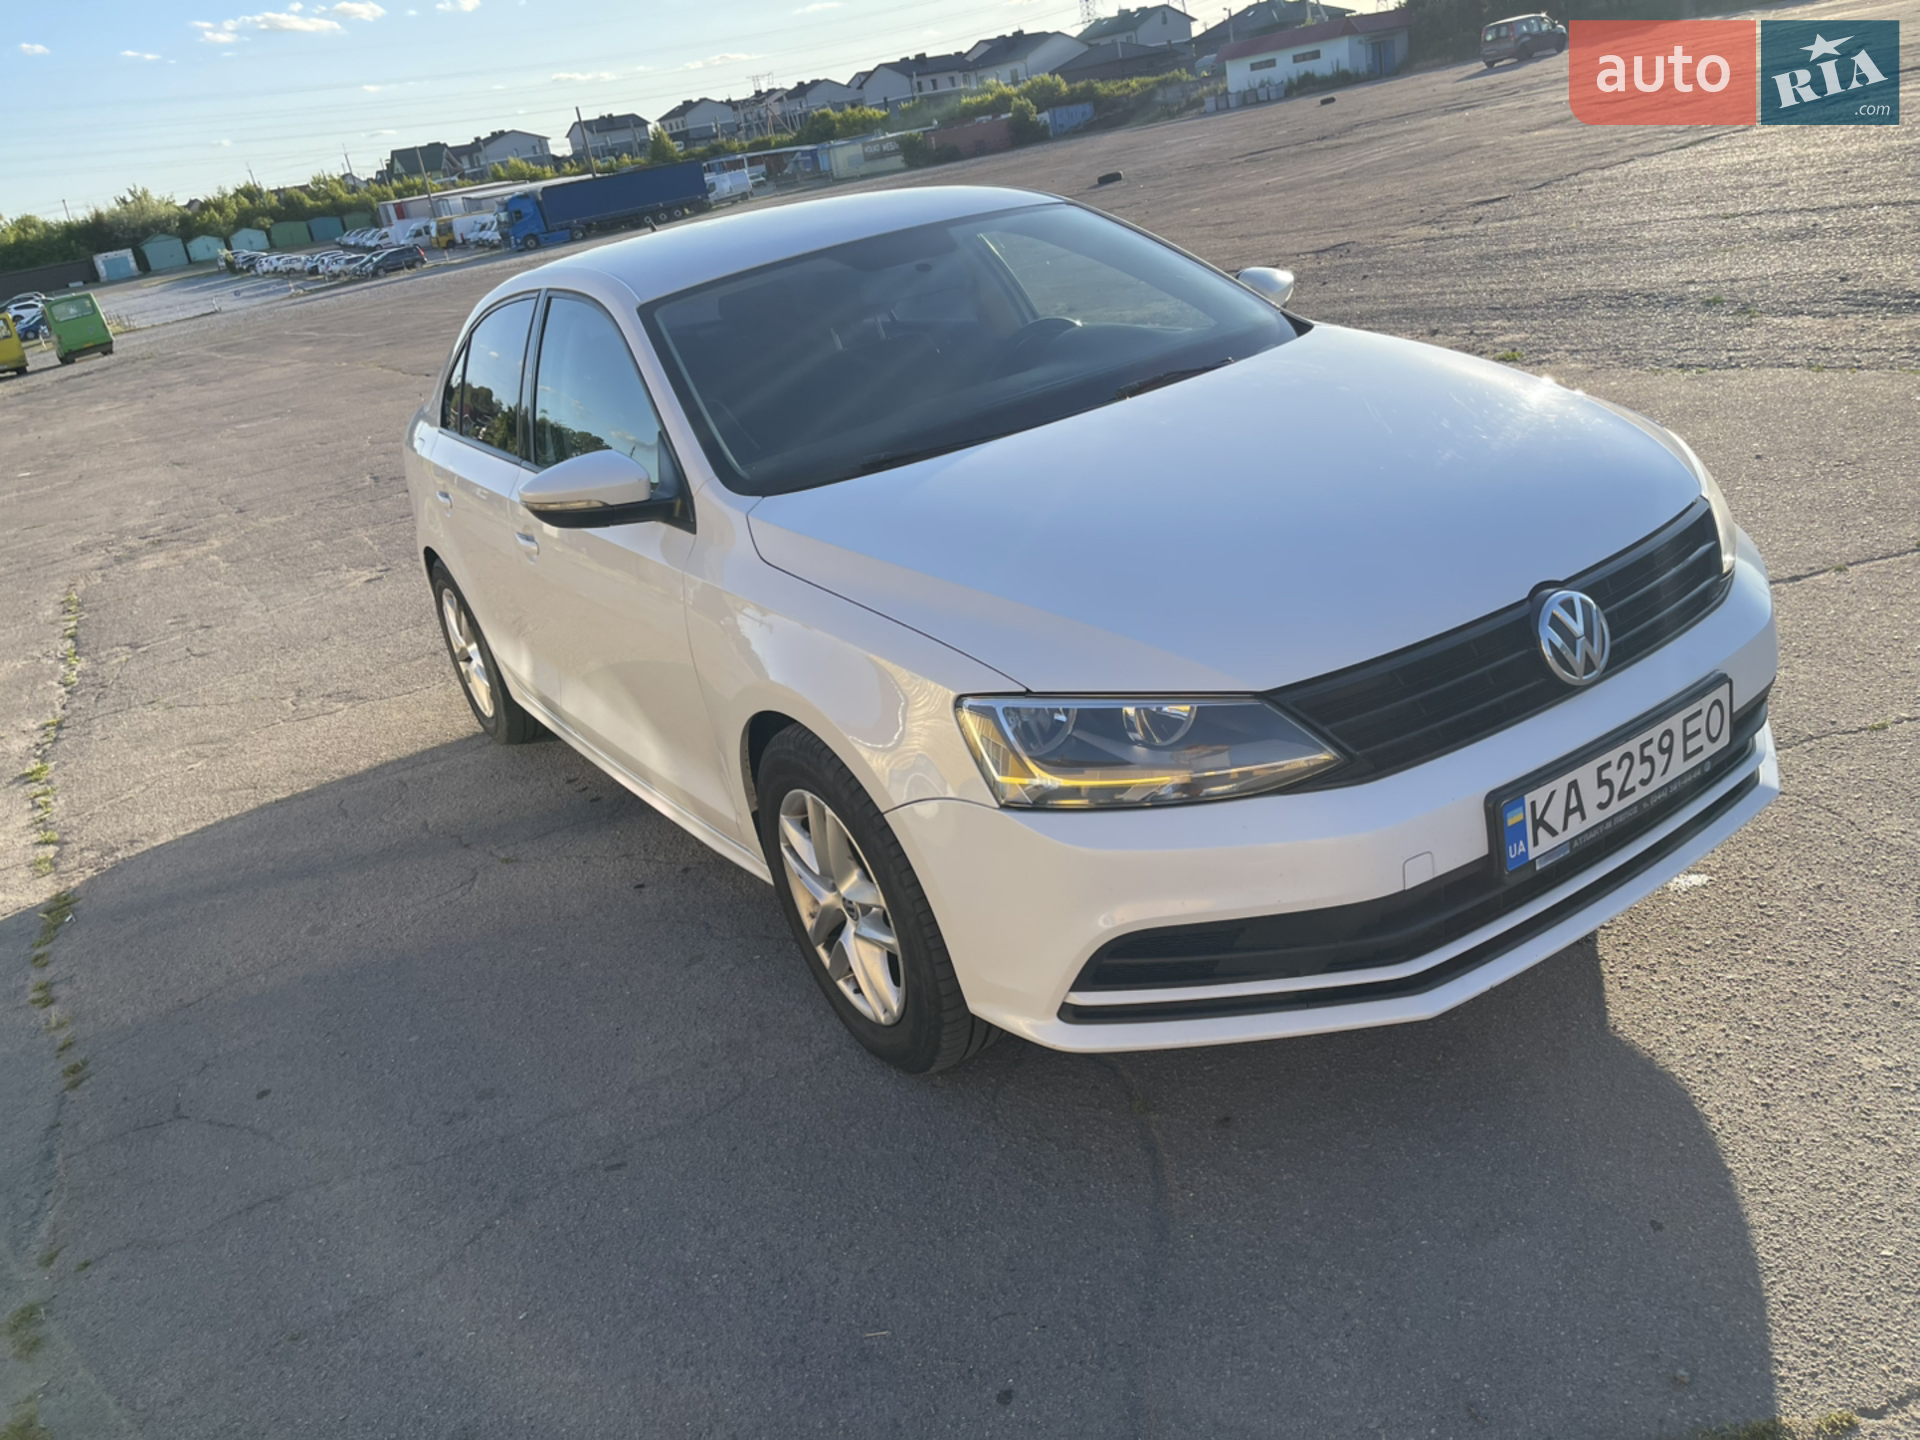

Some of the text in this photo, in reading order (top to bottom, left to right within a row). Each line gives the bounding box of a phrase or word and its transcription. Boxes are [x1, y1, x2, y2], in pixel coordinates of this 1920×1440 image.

[1529, 698, 1725, 848] KA 5259 EO
[1508, 839, 1526, 860] UA
